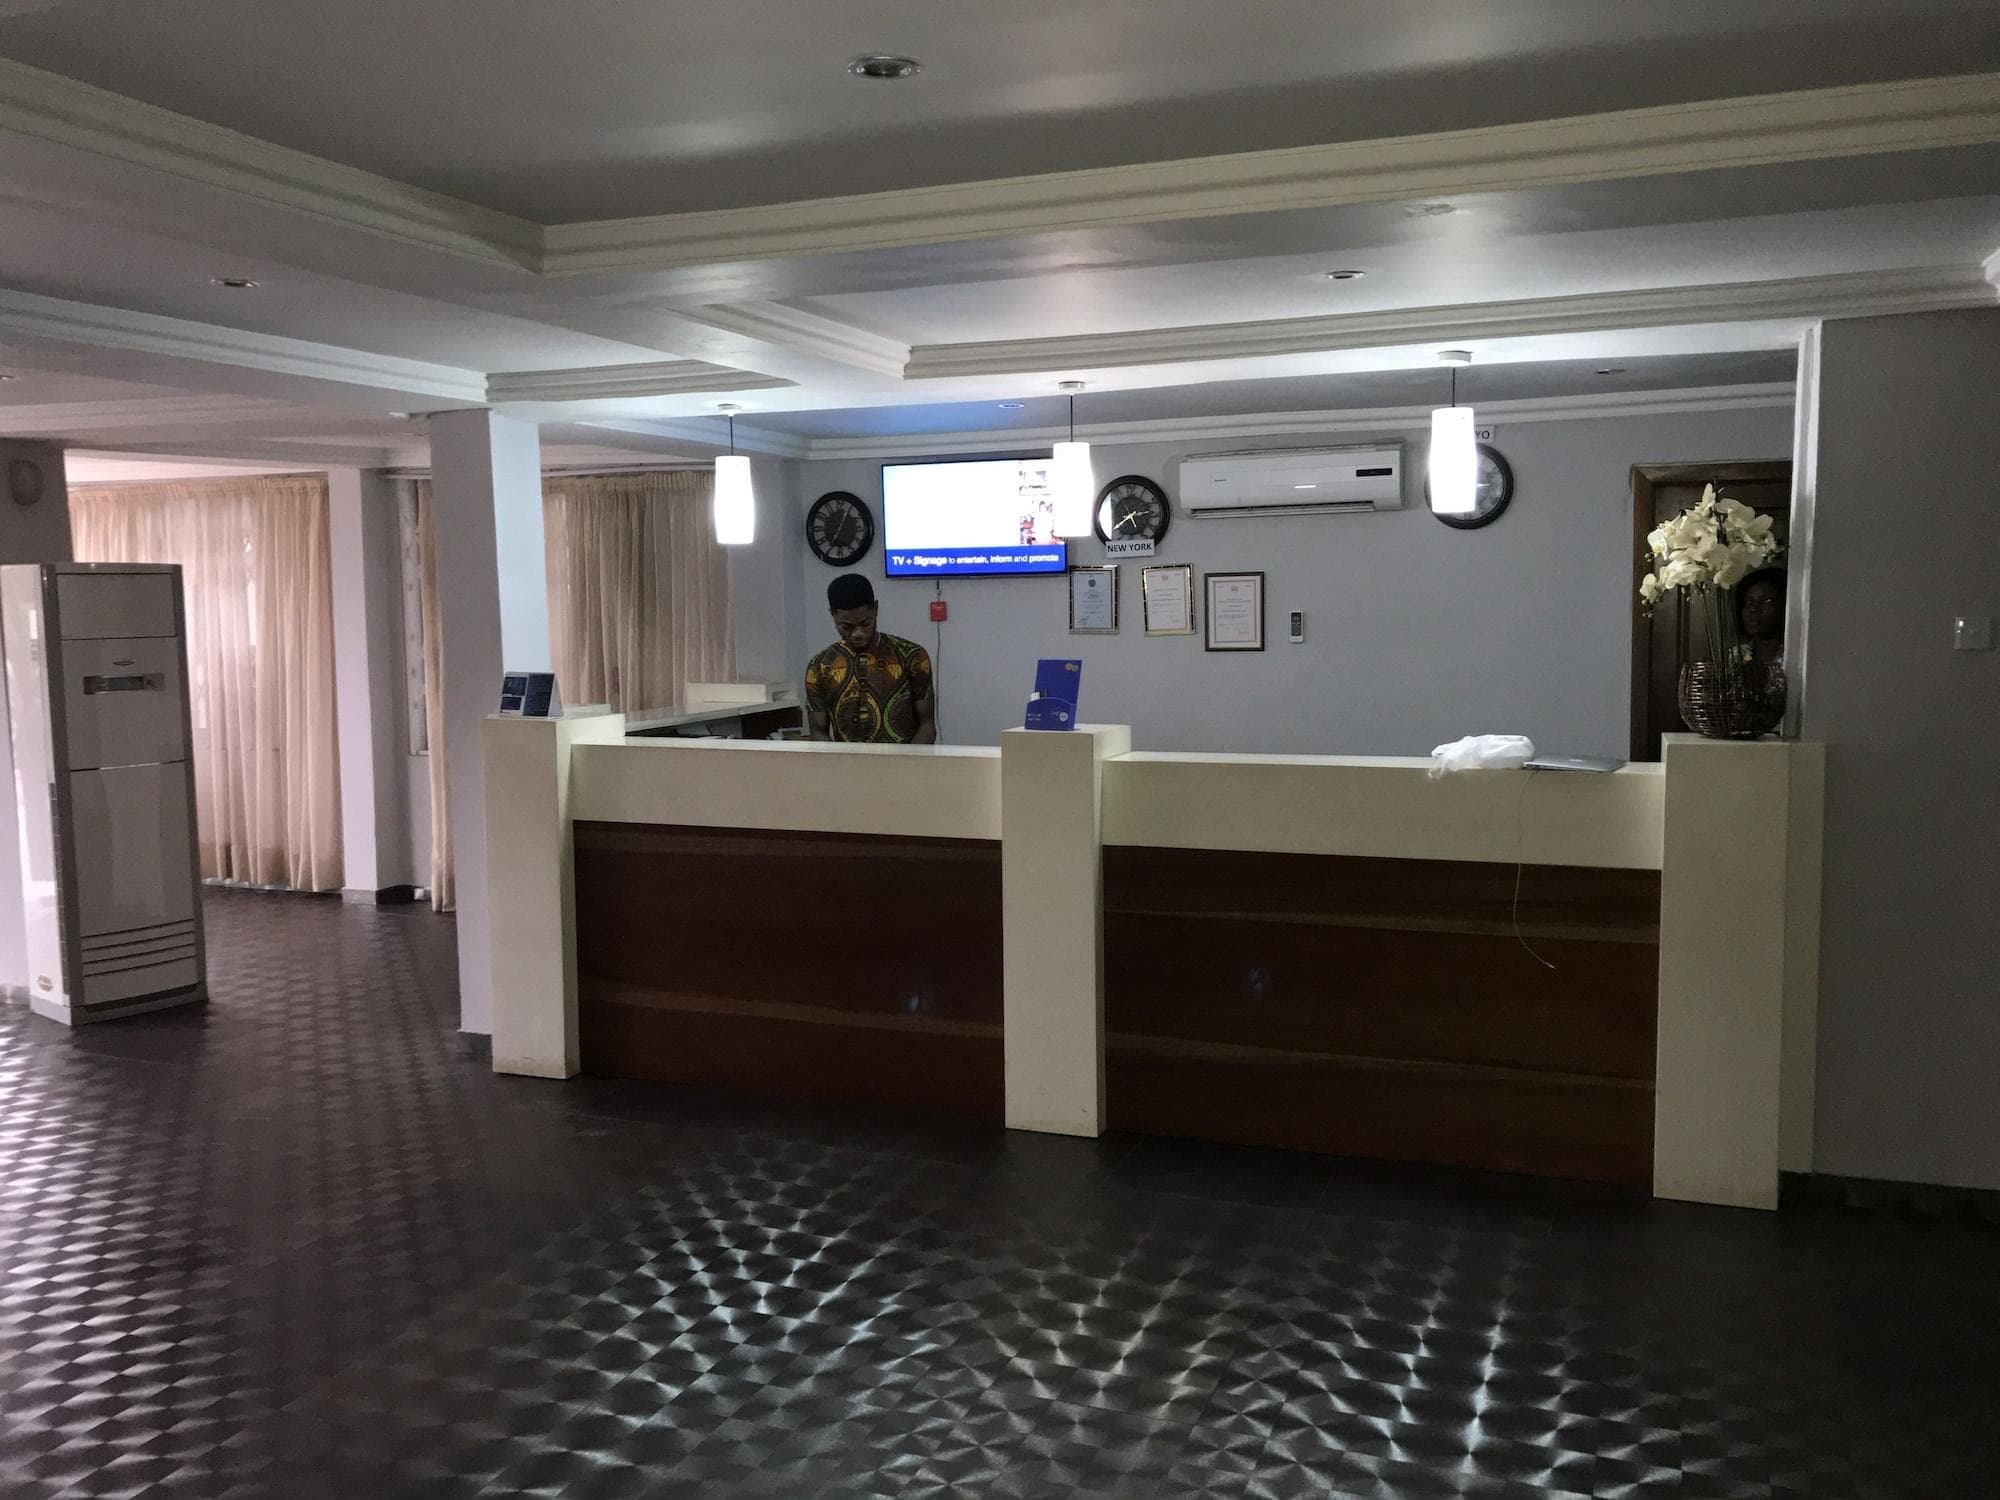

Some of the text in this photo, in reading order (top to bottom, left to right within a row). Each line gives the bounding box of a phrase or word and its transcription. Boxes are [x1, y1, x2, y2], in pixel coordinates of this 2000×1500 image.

[1108, 542, 1152, 552] NEW YORK
[892, 556, 905, 565] TV
[913, 555, 948, 567] Signage
[956, 556, 989, 565] entertain,
[990, 554, 1013, 564] inform
[1013, 554, 1029, 563] and
[1029, 554, 1059, 564] promote
